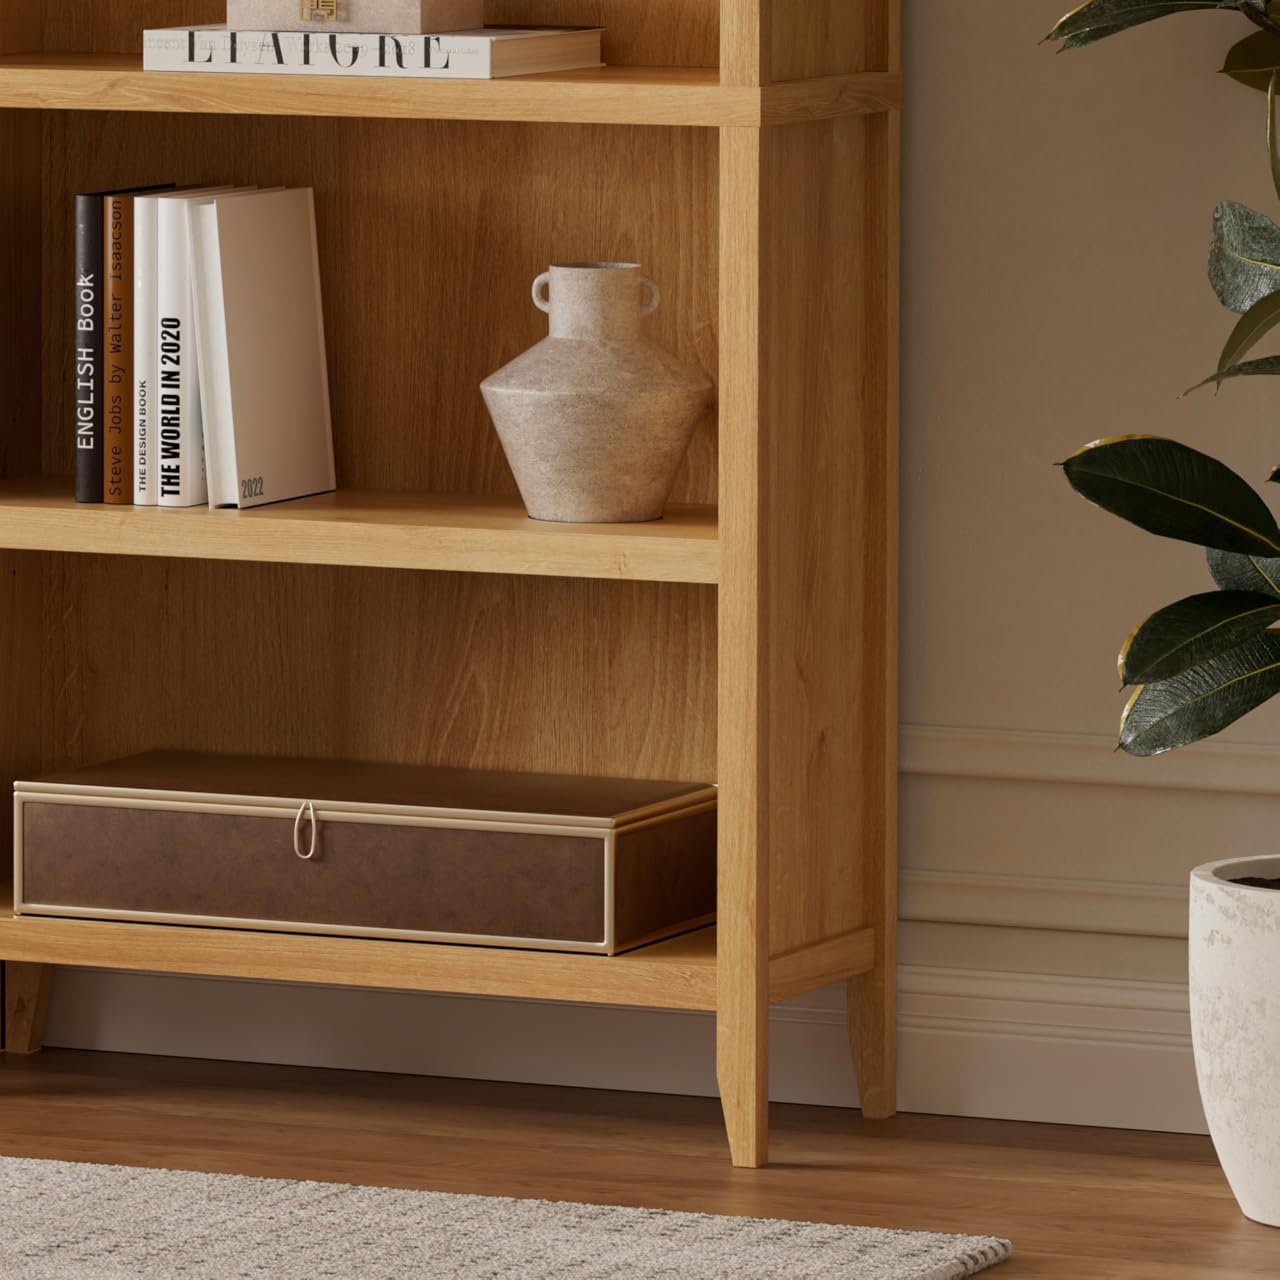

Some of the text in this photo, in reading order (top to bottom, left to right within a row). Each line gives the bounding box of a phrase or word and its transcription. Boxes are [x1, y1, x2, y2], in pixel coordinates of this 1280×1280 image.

[76, 273, 94, 449] ENGLISH Book
[108, 200, 125, 496] Steve Jobs by Walter Isaacson
[138, 380, 147, 492] THE DESIGN BOOK
[161, 317, 181, 497] THE WORLD IN 2020
[241, 476, 264, 499] 2022
